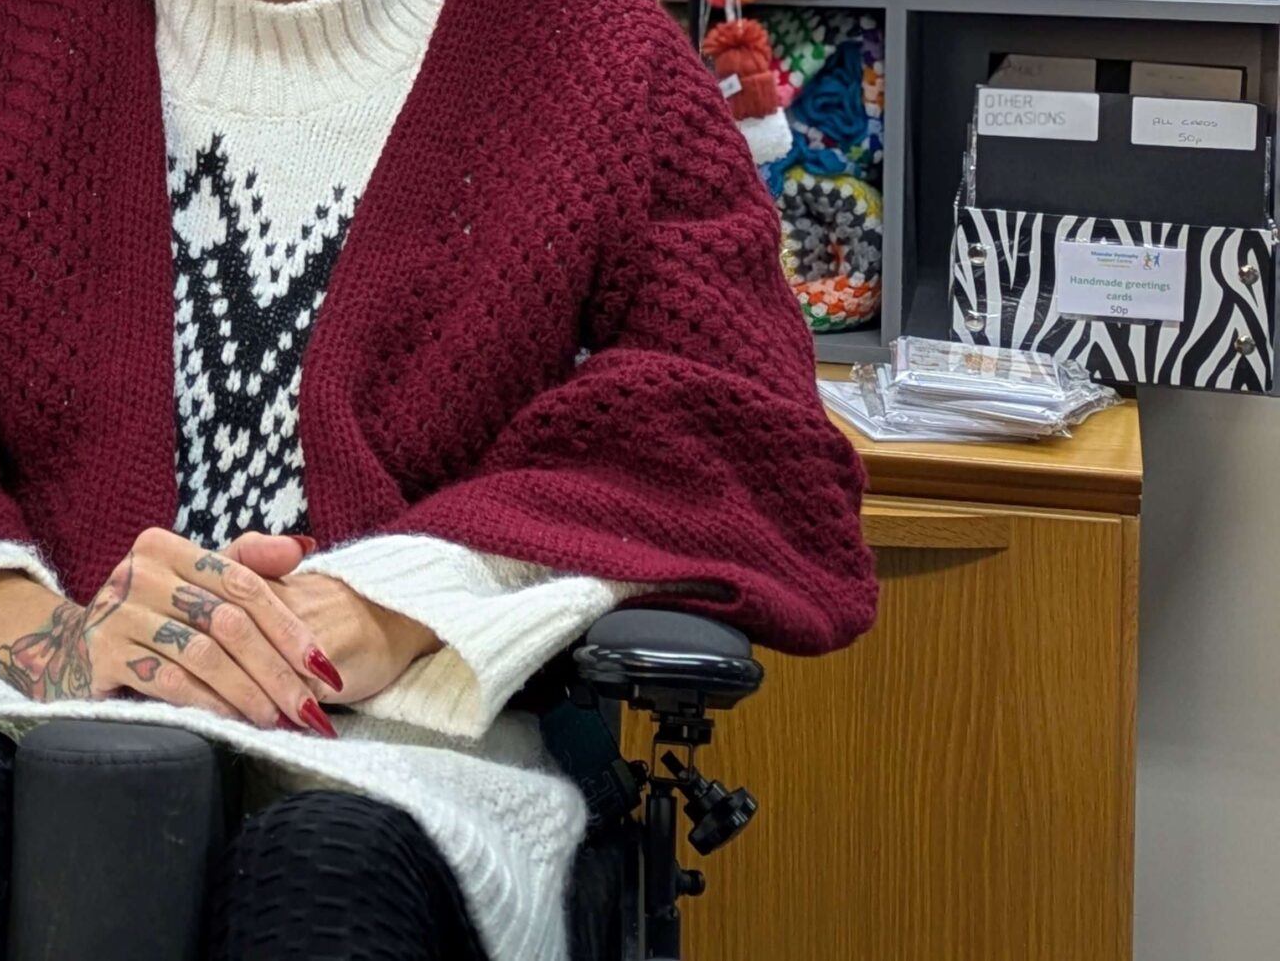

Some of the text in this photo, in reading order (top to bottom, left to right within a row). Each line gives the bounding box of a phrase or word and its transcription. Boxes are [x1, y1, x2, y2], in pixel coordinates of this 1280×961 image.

[984, 94, 1033, 109] OTHER
[985, 111, 1067, 127] OCCASIONS
[1070, 275, 1172, 293] Handmade greetings
[1106, 292, 1133, 302] cards
[1109, 304, 1129, 316] 50p
